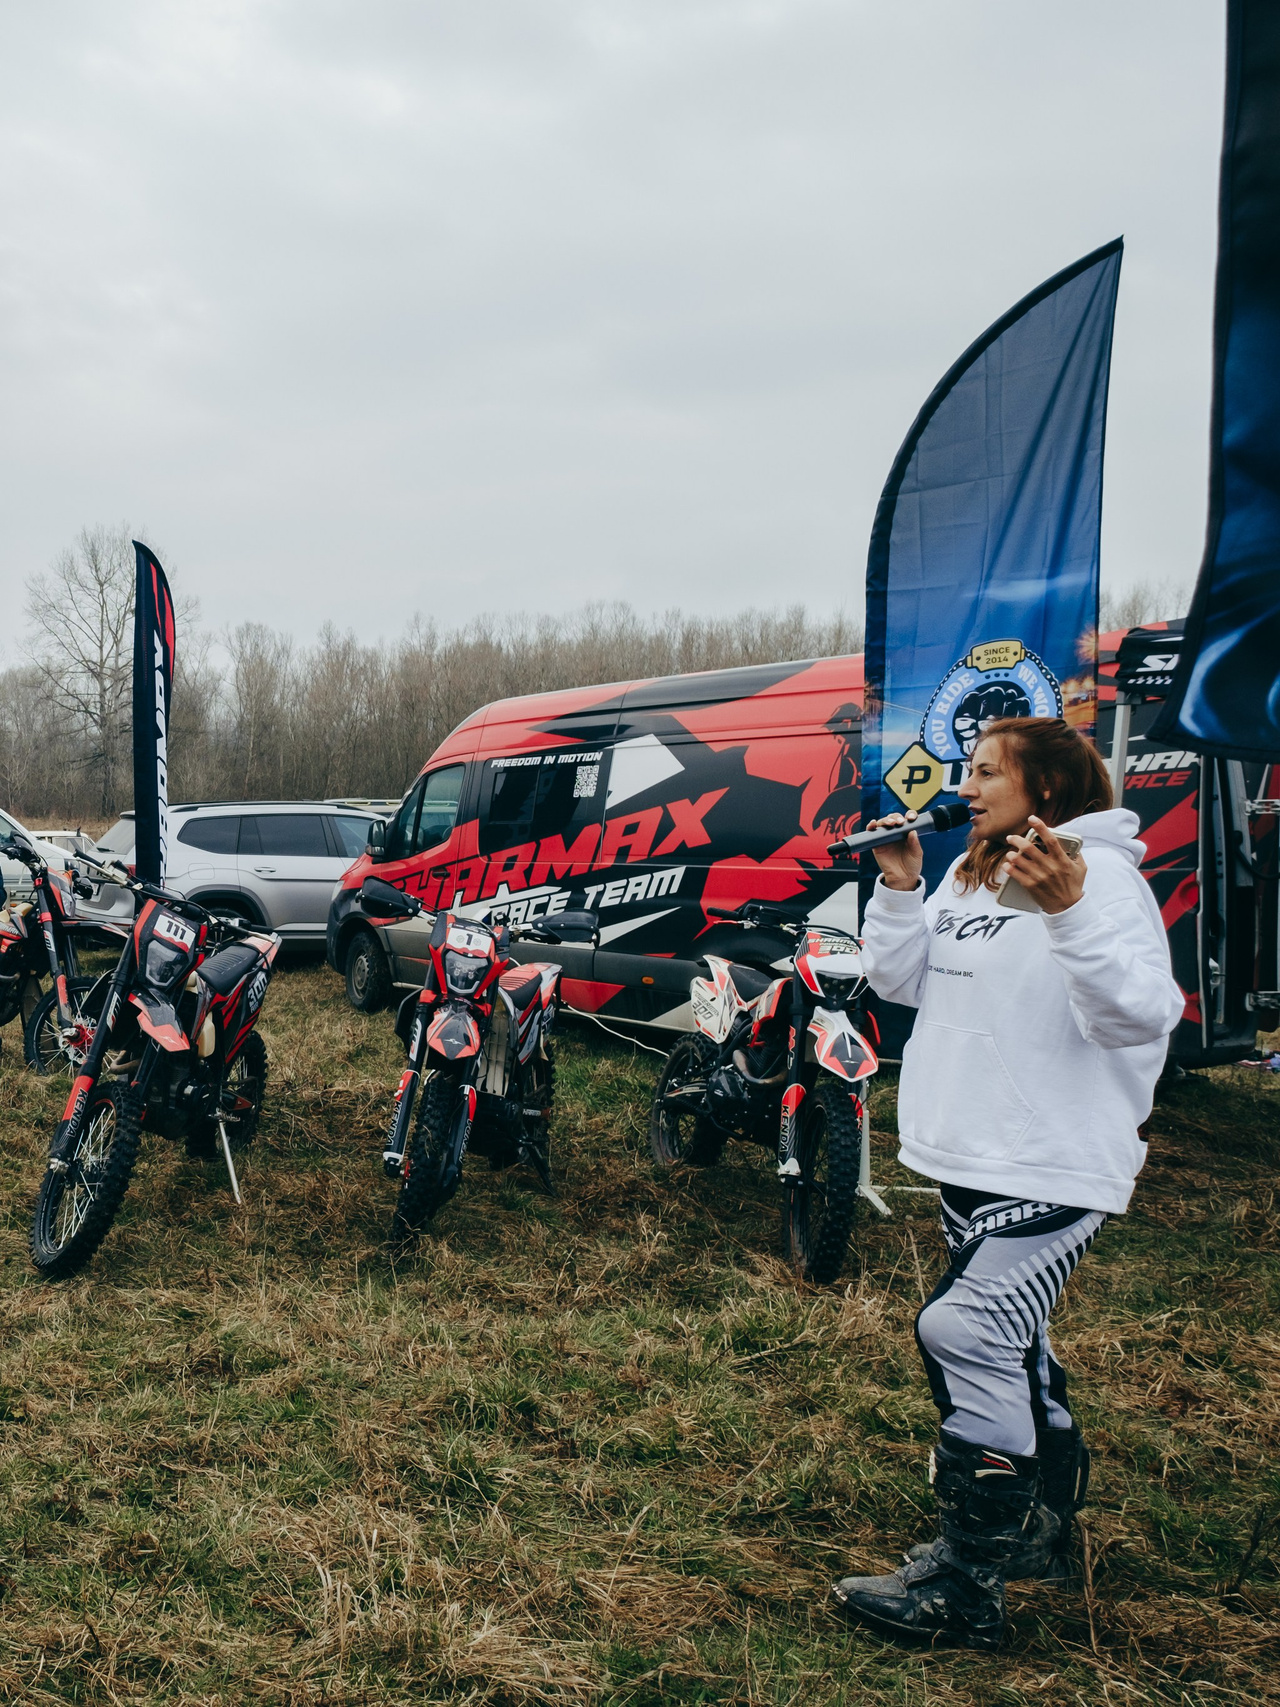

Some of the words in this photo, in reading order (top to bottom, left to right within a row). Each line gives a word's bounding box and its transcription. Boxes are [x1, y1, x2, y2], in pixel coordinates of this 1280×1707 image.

[984, 646, 1010, 656] SINCE
[985, 656, 1008, 665] 2014
[936, 672, 975, 716] RIDE
[1018, 665, 1038, 690] WE
[1033, 686, 1050, 718] WO
[932, 719, 951, 756] YOU
[491, 757, 542, 768] FREEDOM
[543, 756, 556, 764] IN
[557, 752, 603, 764] MOTION
[1124, 771, 1192, 790] ACE
[584, 866, 687, 910] TEAM
[166, 920, 186, 940] 111
[466, 933, 473, 946] 1
[955, 914, 1024, 944] CAT
[692, 1000, 714, 1020] 300
[65, 1087, 89, 1138] KENDA
[386, 1101, 402, 1145] KENDA
[780, 1105, 790, 1152] KENDA
[962, 1202, 1061, 1246] SHAR
